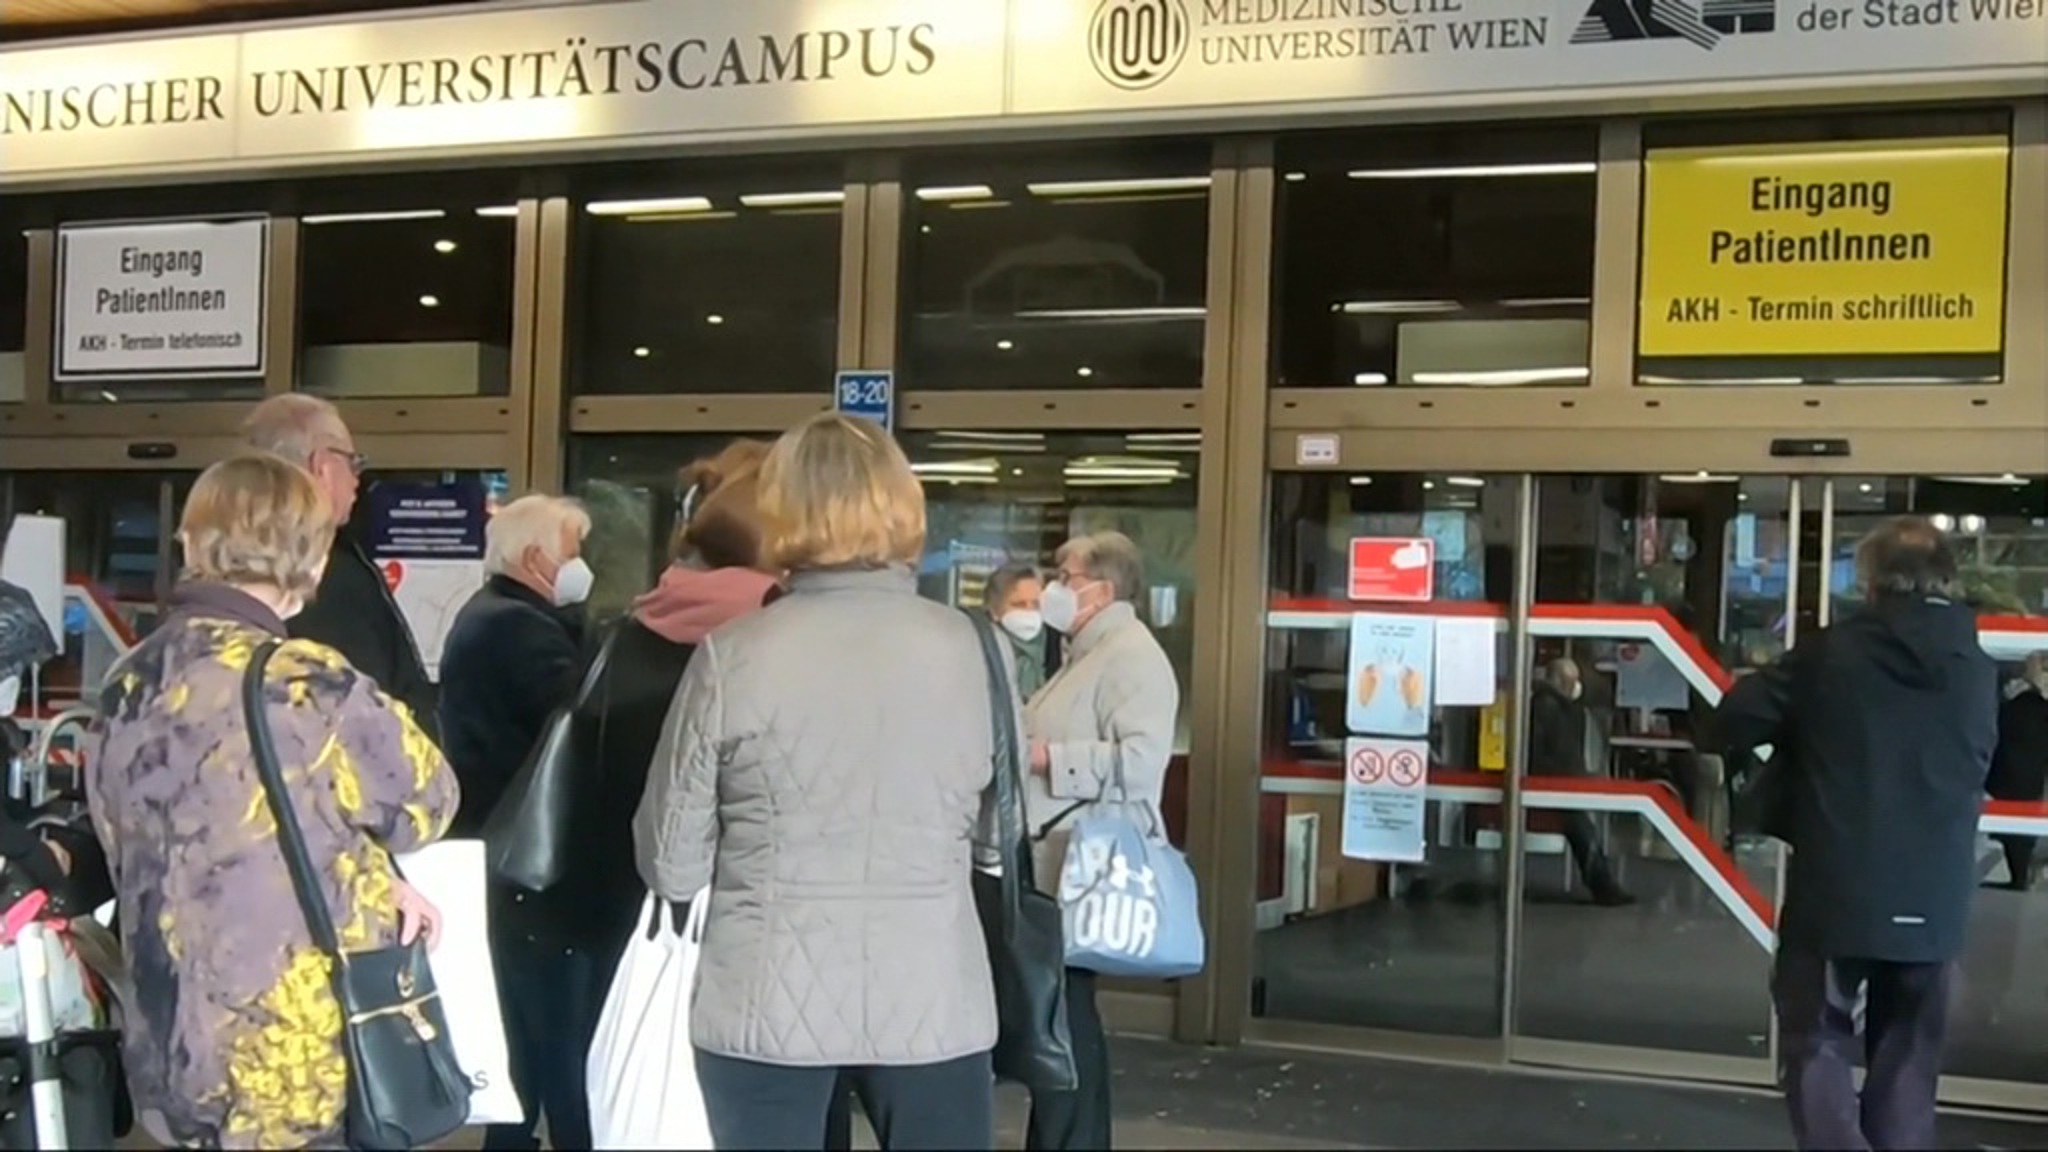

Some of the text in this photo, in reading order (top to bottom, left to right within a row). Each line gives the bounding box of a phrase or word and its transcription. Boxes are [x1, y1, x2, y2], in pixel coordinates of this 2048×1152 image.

[1797, 3, 1852, 31] der
[1863, 0, 1959, 28] Stadt
[1200, 17, 1549, 65] UNIVERSITÄT WIEN
[1, 22, 938, 134] NISCHER UNIVERSITÄTSCAMPUS
[1752, 177, 1891, 216] Eingang
[1711, 228, 1930, 264] PatientInnen
[120, 247, 203, 278] Eingang
[96, 286, 225, 314] PatientInnen
[1667, 298, 1719, 321] AKH
[1748, 296, 1833, 321] Termin
[1842, 294, 1974, 320] schriftlich
[79, 335, 107, 350] AKH
[121, 334, 164, 350] Termin
[841, 380, 888, 404] 18-20
